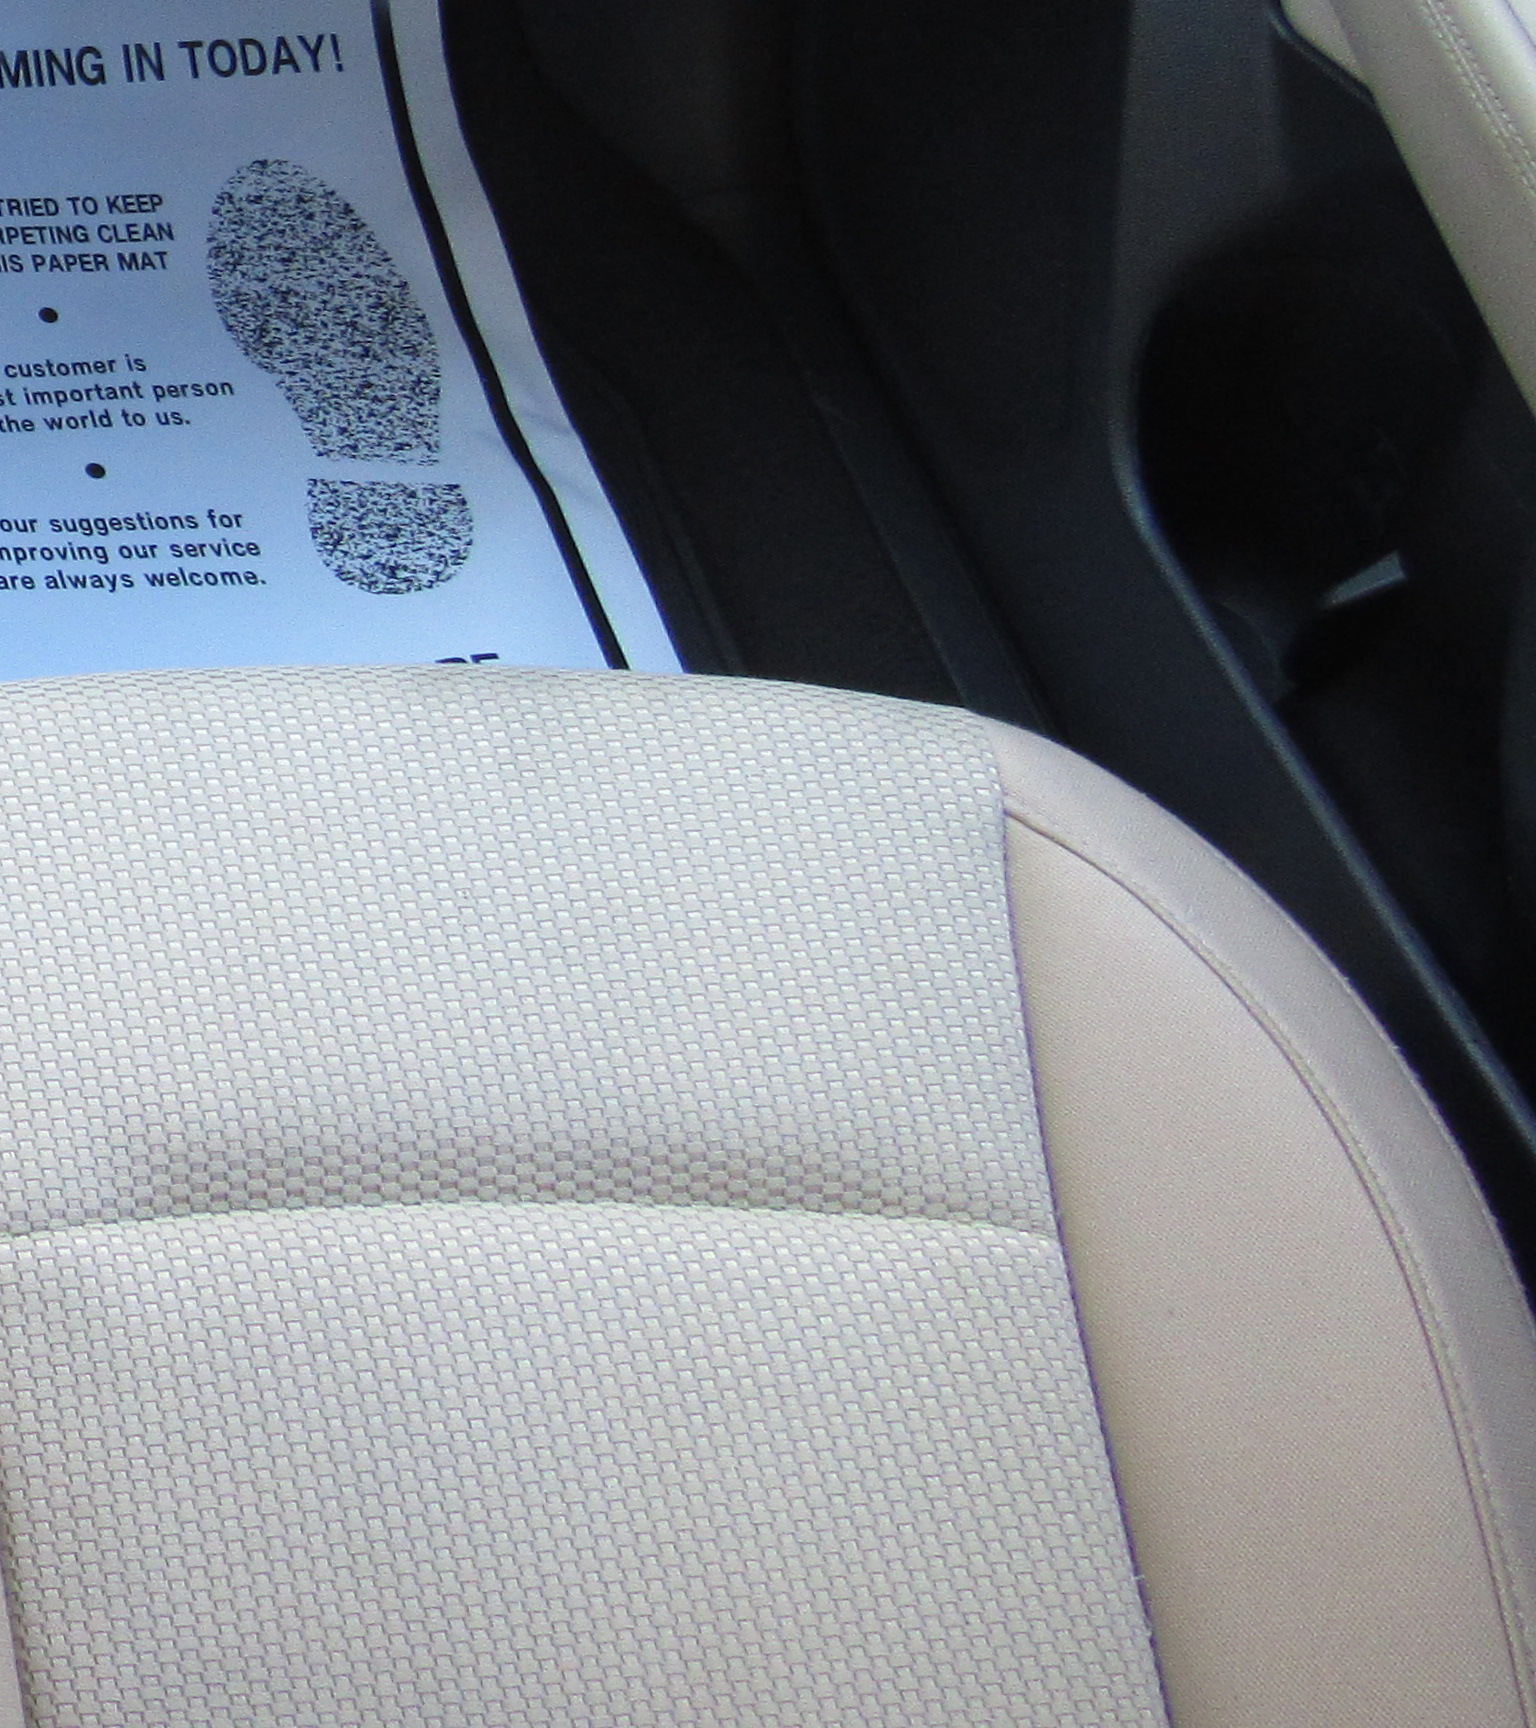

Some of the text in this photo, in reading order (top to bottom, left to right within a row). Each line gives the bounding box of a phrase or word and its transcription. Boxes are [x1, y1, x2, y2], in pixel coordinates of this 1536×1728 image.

[123, 42, 165, 83] IN
[177, 33, 345, 79] TODAY!
[67, 196, 98, 215] TO
[105, 194, 163, 214] KEEP
[97, 222, 174, 243] CLEAN
[32, 253, 109, 272] PAPER
[116, 251, 168, 271] MAT
[4, 357, 116, 378] customer
[125, 353, 147, 372] is
[23, 380, 144, 408] important
[152, 380, 235, 402] person
[42, 409, 113, 431] world
[121, 408, 146, 427] to
[155, 409, 191, 427] us.
[49, 511, 199, 536] suggestions
[207, 509, 243, 529] for
[118, 543, 158, 559] our
[169, 537, 261, 558] service
[44, 569, 135, 593] always
[143, 567, 267, 588] welcome.
